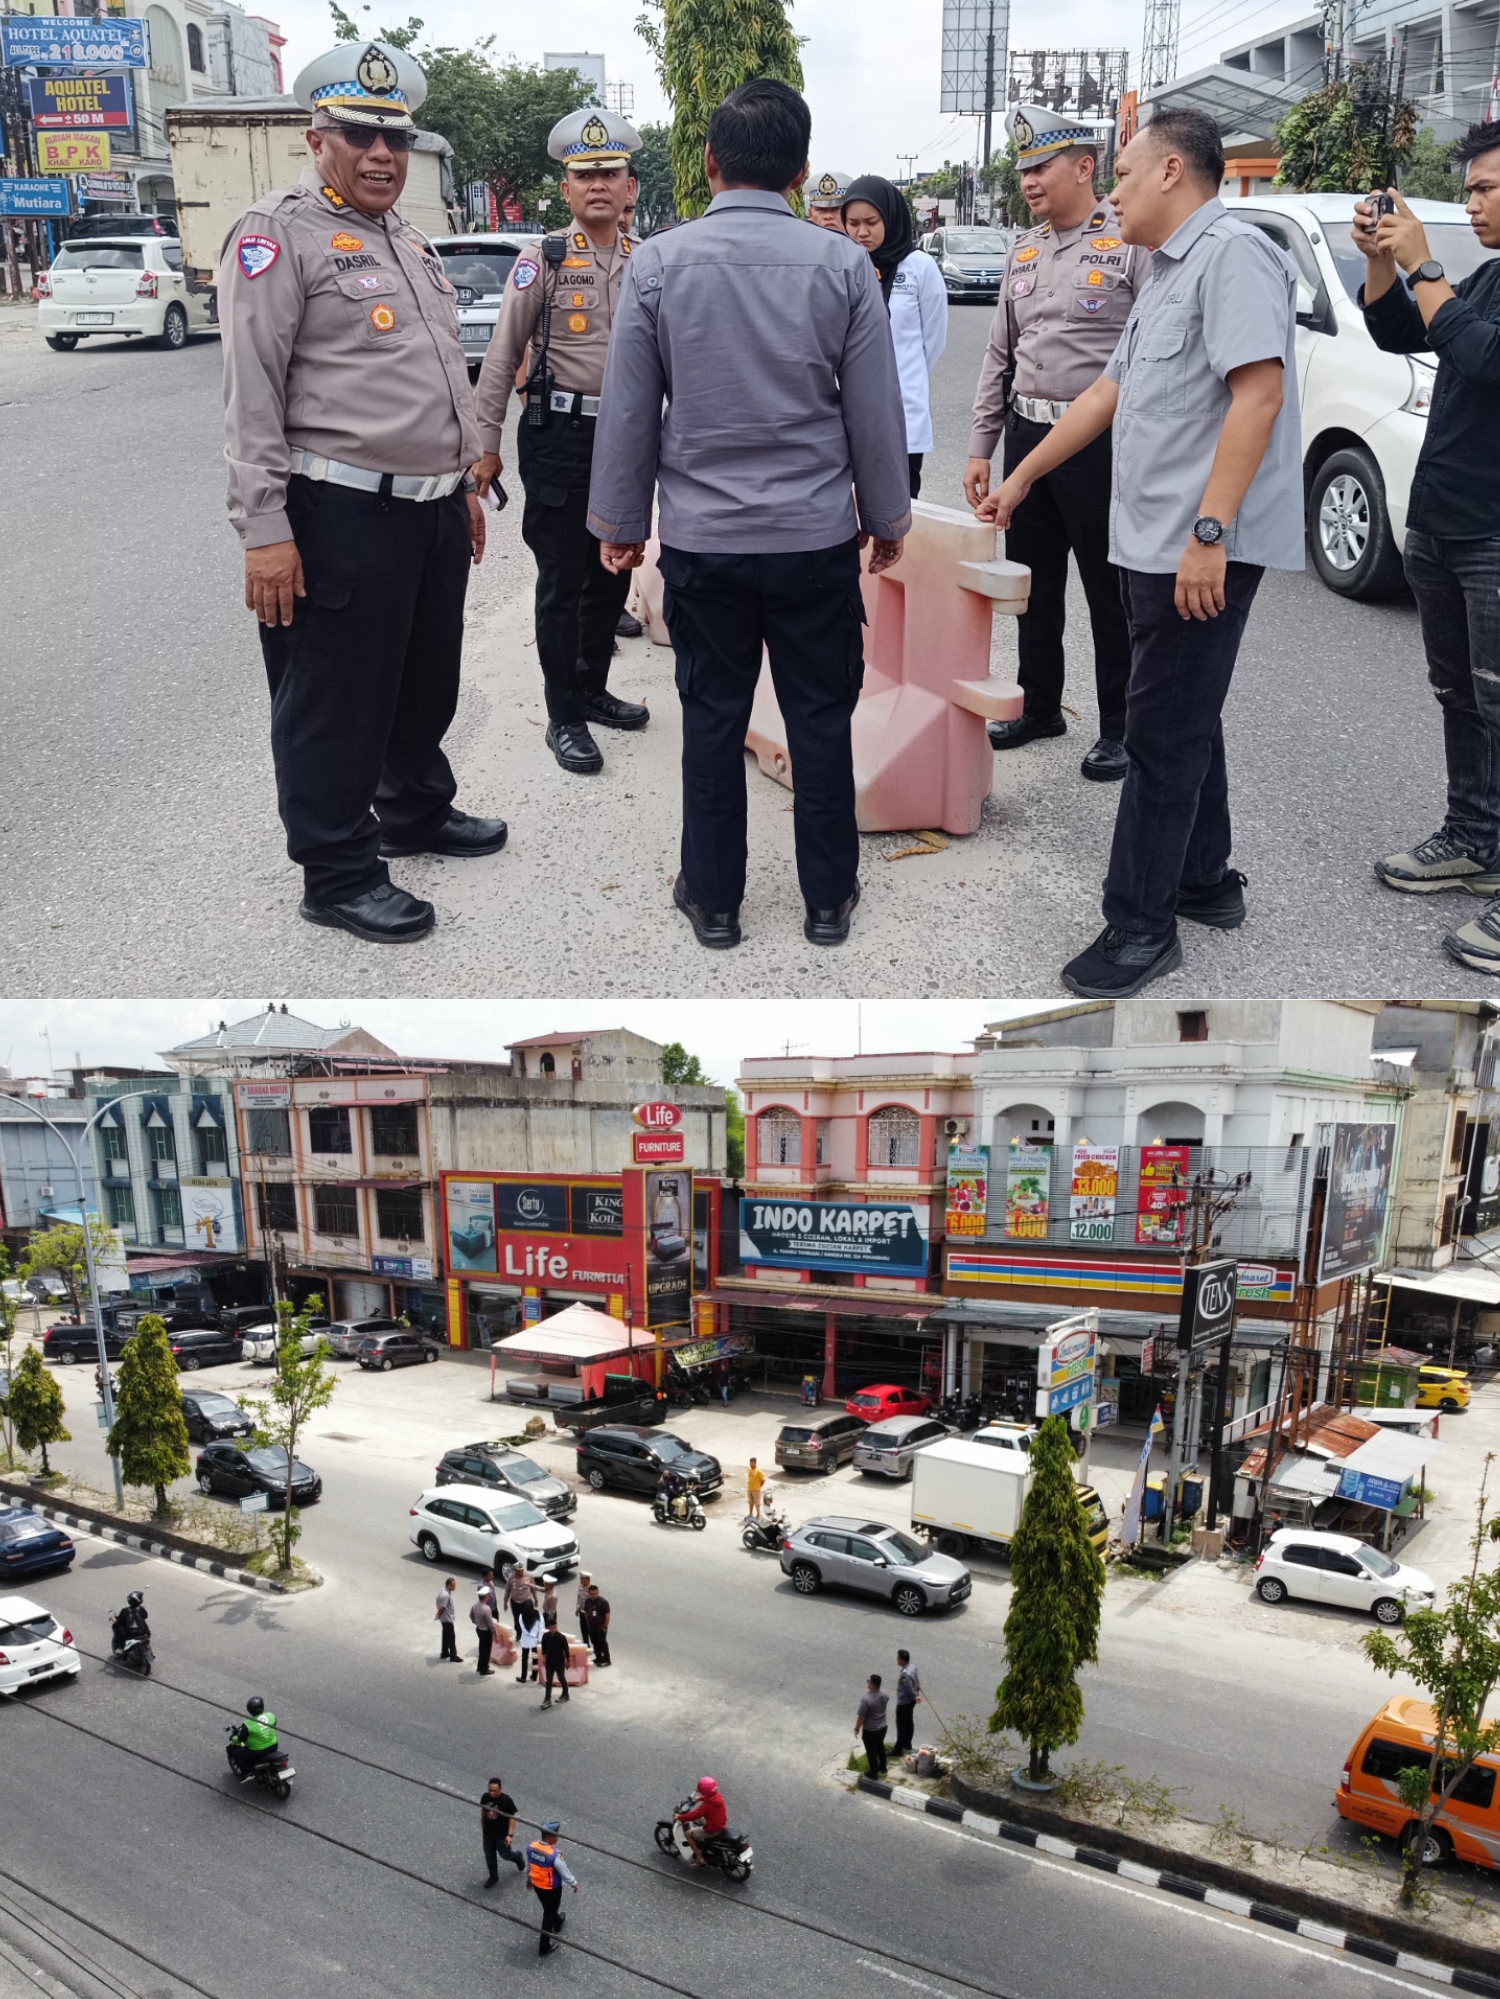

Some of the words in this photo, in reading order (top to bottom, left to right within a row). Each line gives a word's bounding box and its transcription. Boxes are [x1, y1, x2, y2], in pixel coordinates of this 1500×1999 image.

[42, 19, 90, 27] WELCOME
[8, 28, 58, 40] HOTEL
[61, 28, 126, 45] AQUATEL
[45, 79, 110, 96] AQUATEL
[56, 96, 102, 112] HOTEL
[44, 133, 71, 145] RUMAH
[73, 133, 101, 145] MAKAN
[46, 146, 59, 159] B
[67, 146, 78, 158] P
[86, 146, 100, 158] K
[14, 183, 49, 191] KARAOKE
[14, 197, 62, 209] Mutiara
[334, 254, 382, 272] DASRIL
[1079, 254, 1122, 267] POLRI
[646, 1105, 674, 1125] Life
[638, 1142, 681, 1153] FURNITURE
[1076, 1178, 1115, 1195] 13.000
[522, 1196, 540, 1211] Serta
[595, 1196, 623, 1207] KING
[590, 1212, 615, 1223] KOIL
[753, 1205, 813, 1233] INDO
[819, 1208, 914, 1239] KARPET
[1075, 1223, 1112, 1240] 12.000
[834, 1235, 857, 1243] LOKAL
[864, 1237, 891, 1245] IMPORT
[843, 1244, 868, 1252] KARPET
[505, 1244, 568, 1279] Life
[648, 1280, 687, 1295] UPGRADE
